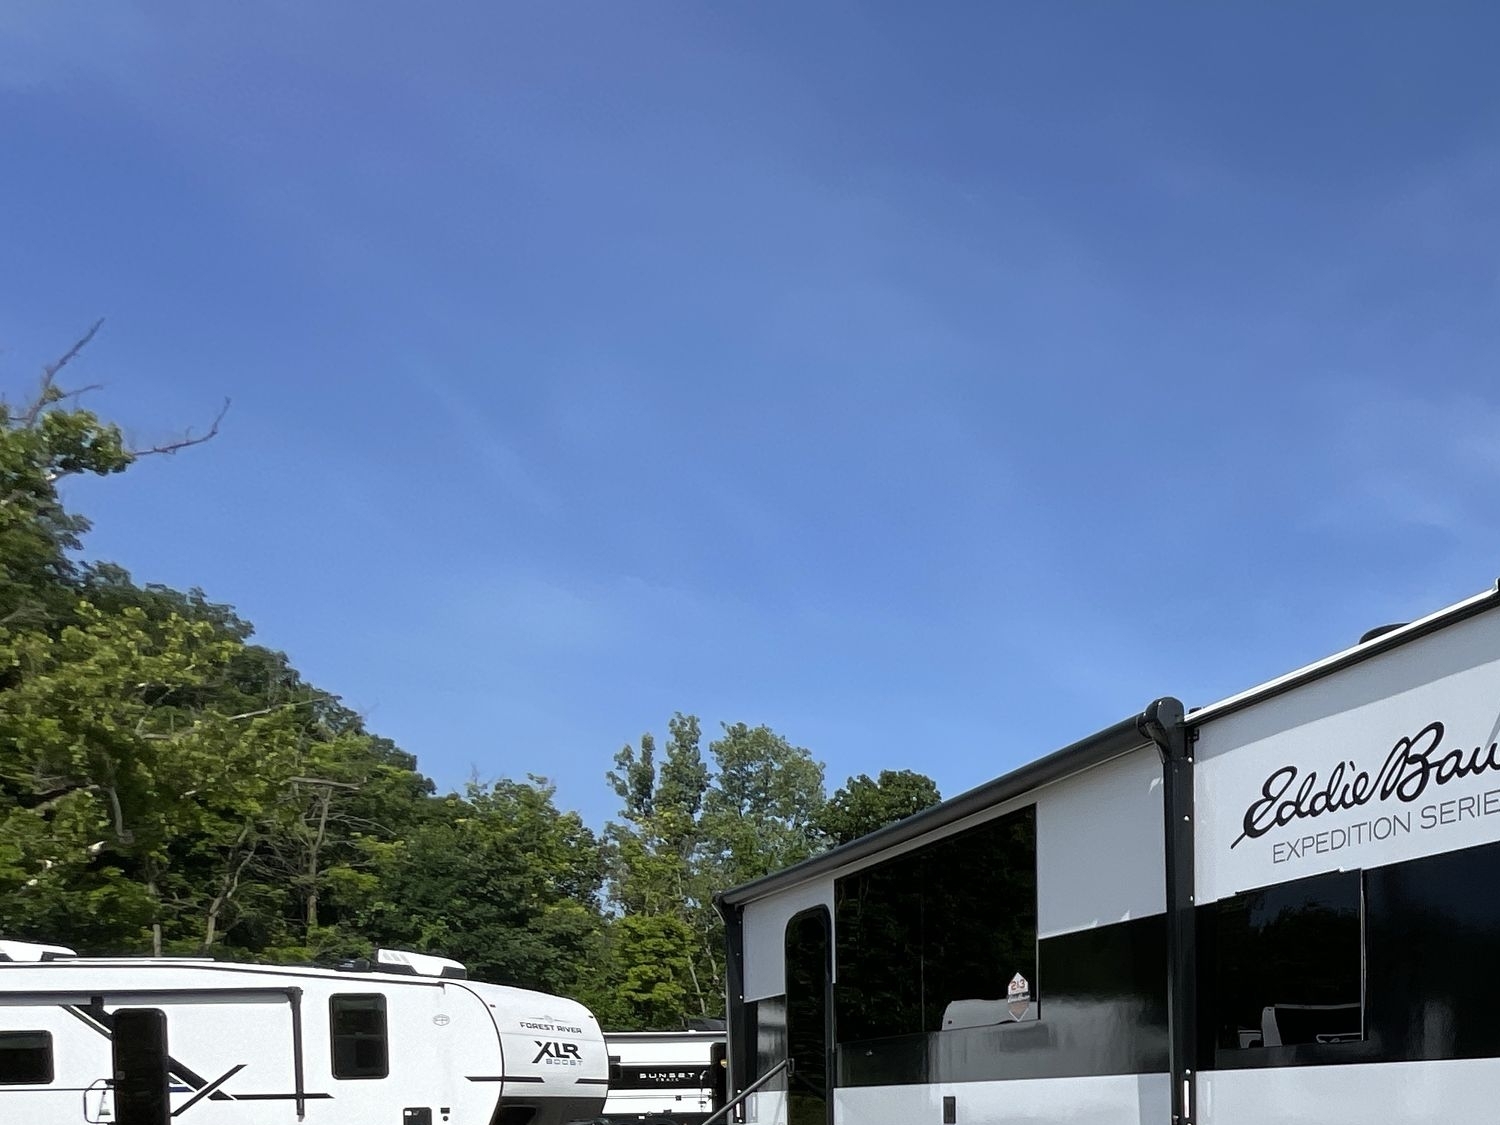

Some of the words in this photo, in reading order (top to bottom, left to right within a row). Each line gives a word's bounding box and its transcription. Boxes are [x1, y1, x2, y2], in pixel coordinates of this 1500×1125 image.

[1231, 761, 1382, 849] Eddie
[1272, 811, 1411, 864] EXPEDITION
[519, 1021, 555, 1032] FOREST
[556, 1025, 583, 1034] RIVER
[531, 1040, 583, 1064] XLR
[545, 1058, 584, 1066] BOOST
